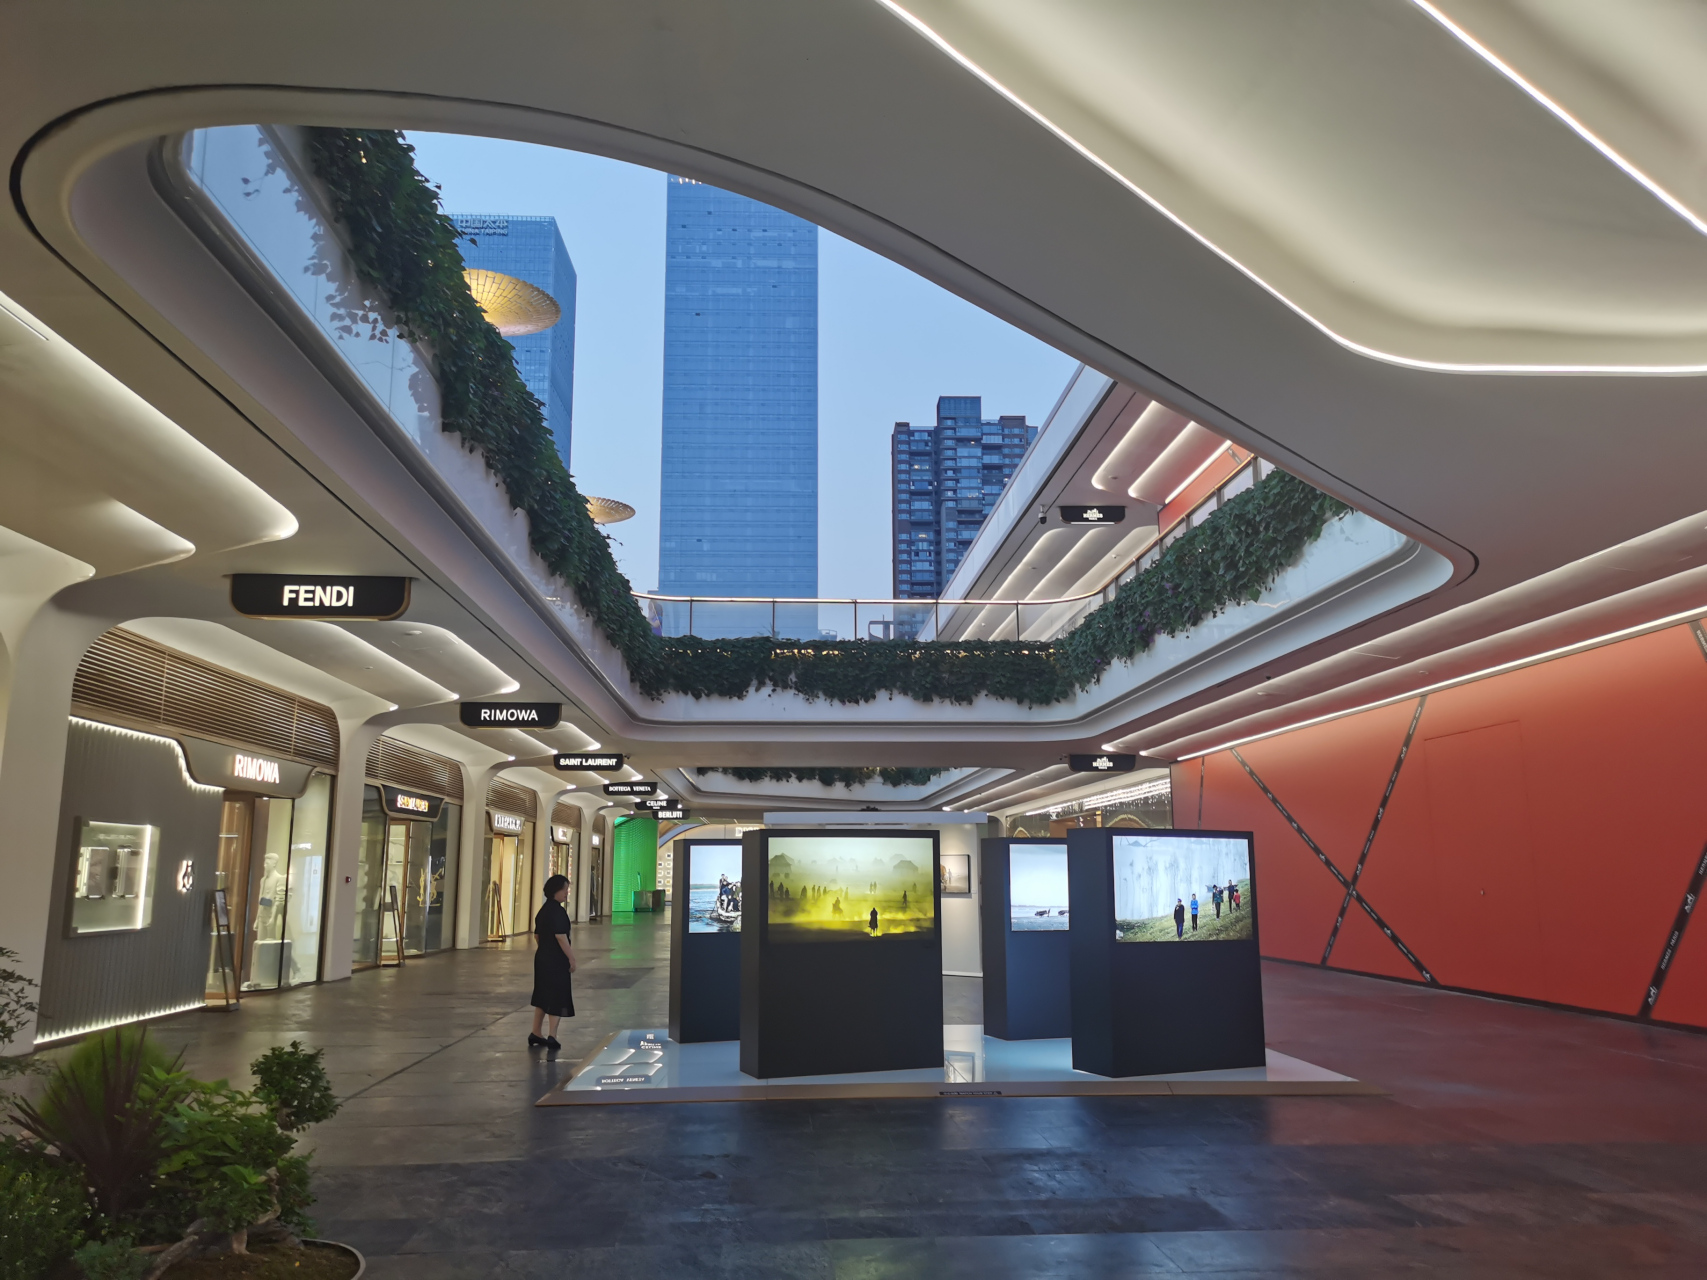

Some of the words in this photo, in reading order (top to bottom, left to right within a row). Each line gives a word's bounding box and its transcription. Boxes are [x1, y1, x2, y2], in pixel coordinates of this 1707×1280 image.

[282, 584, 355, 608] FENDI
[481, 708, 539, 721] RIMOWA
[559, 758, 582, 766] SAINT
[582, 758, 618, 766] LAURENT
[234, 754, 280, 784] RIMOWA
[658, 811, 683, 819] BERLUTI
